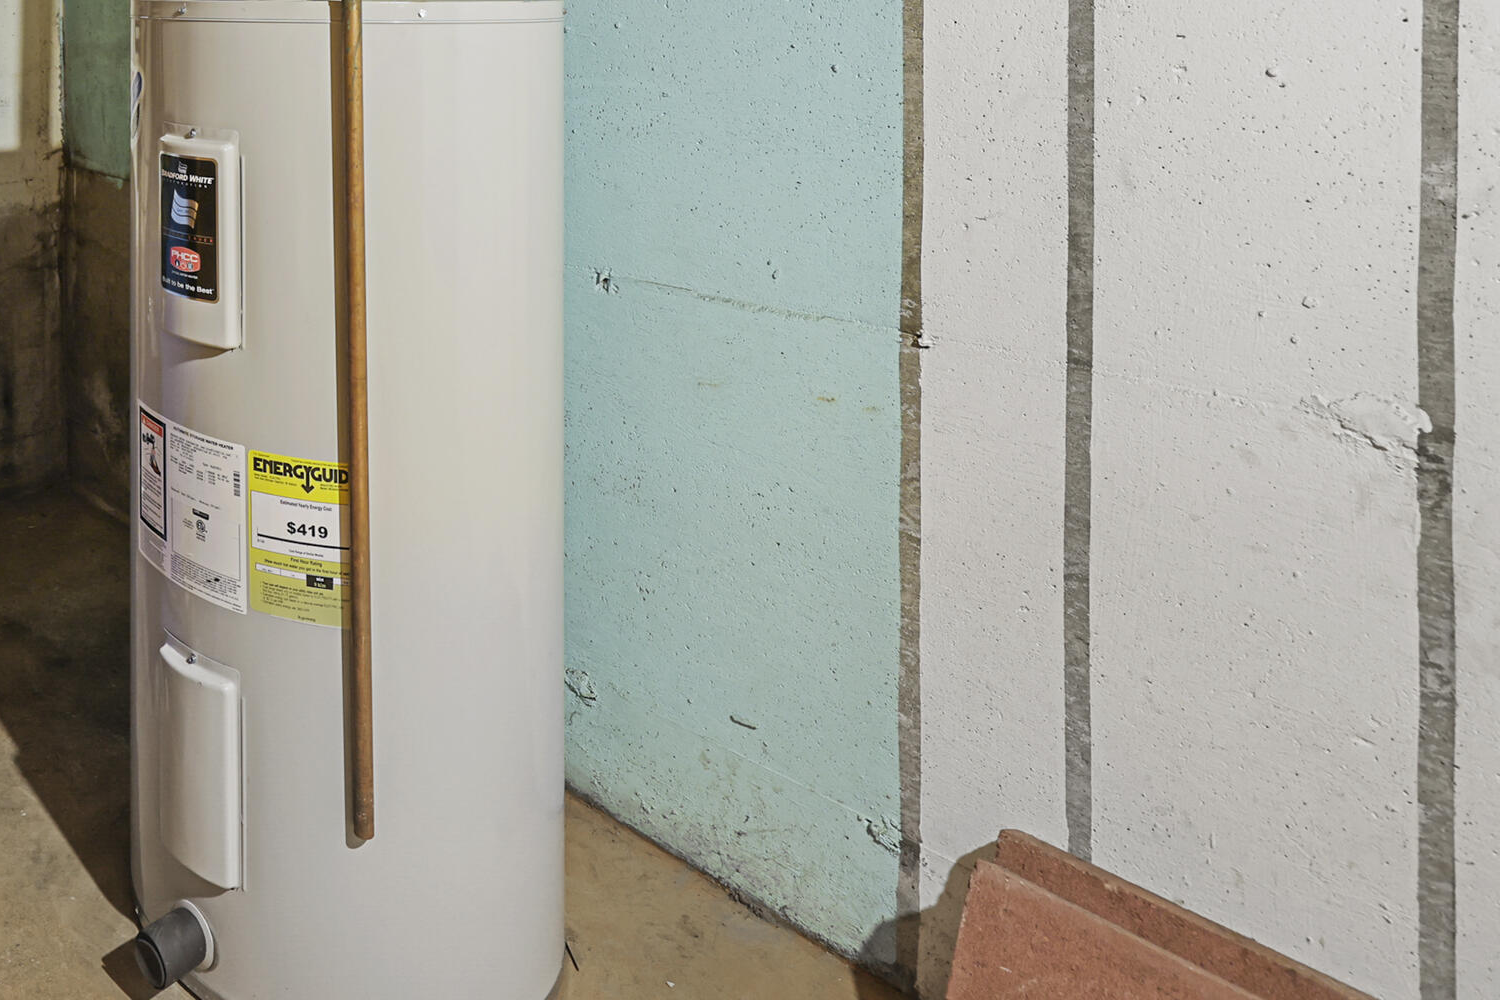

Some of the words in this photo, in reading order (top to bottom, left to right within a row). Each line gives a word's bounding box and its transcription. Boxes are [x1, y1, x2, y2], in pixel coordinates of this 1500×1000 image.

[161, 168, 189, 182] BRADFORD
[189, 174, 214, 185] WHITE
[171, 249, 199, 263] PHCC
[177, 281, 184, 289] be
[185, 283, 195, 292] the
[197, 286, 213, 295] Best
[253, 456, 349, 485] ENERGYGUID
[286, 521, 329, 539] $419
